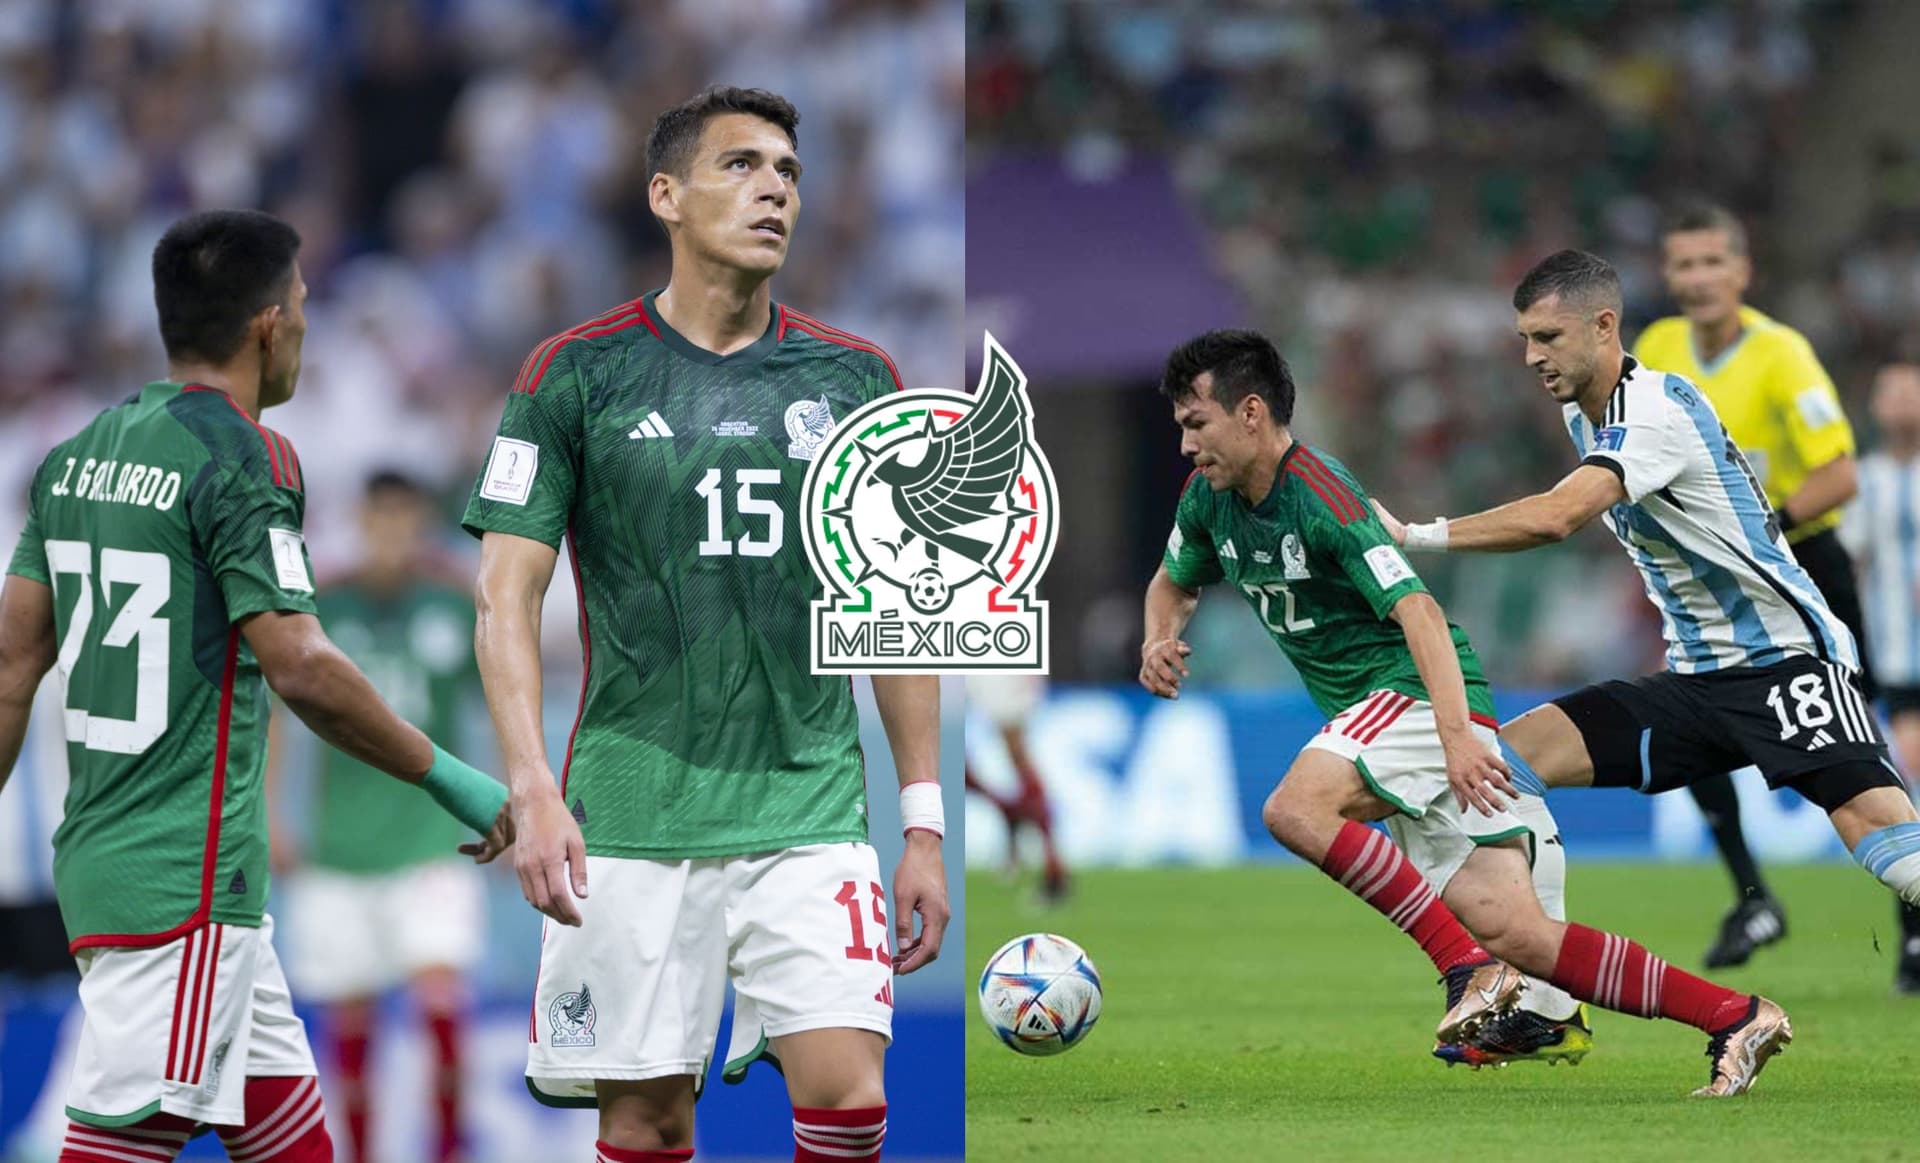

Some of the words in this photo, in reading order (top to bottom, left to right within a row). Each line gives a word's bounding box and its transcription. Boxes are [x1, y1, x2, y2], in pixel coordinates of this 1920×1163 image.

[51, 457, 77, 496] J.
[694, 468, 784, 557] 15
[1242, 583, 1315, 634] 22
[45, 540, 171, 754] 23
[1766, 672, 1834, 741] 18
